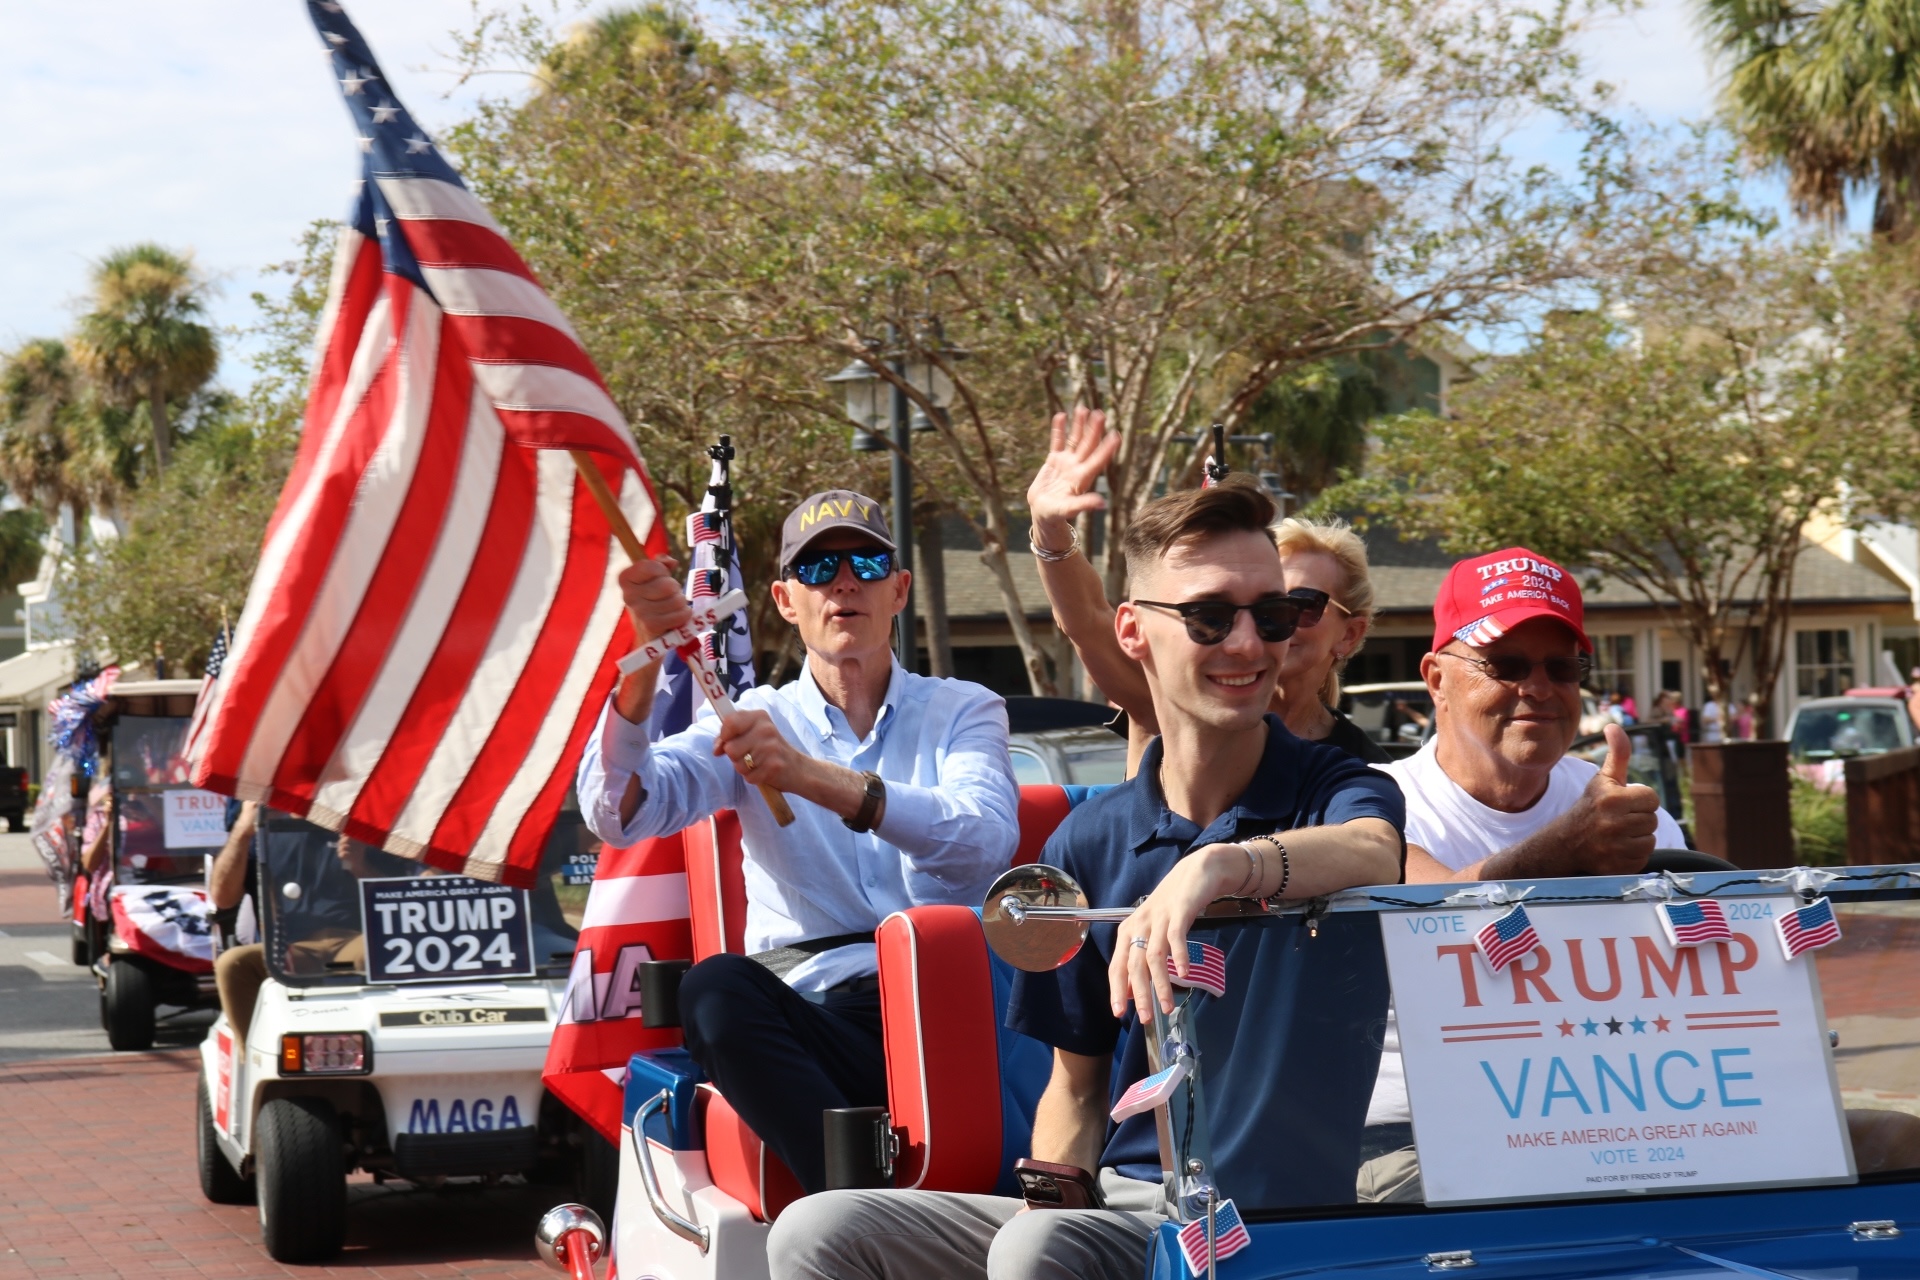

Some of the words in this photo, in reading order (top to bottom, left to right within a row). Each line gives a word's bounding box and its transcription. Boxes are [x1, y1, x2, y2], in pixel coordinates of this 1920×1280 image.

[800, 499, 869, 532] NAVY
[1477, 557, 1563, 582] TRUMP
[1521, 575, 1553, 591] 2024
[1479, 593, 1504, 608] TAKE
[1507, 589, 1549, 600] AMERICA
[1550, 595, 1570, 611] BACK
[375, 891, 403, 899] MAKE
[404, 889, 448, 898] AMERICA
[448, 887, 480, 896] GREAT
[481, 885, 513, 894] AGAIN
[374, 897, 516, 935] TRUMP
[1728, 902, 1774, 921] 2024
[1406, 915, 1467, 935] VOTE
[383, 932, 516, 974] 2024
[1436, 932, 1759, 1007] TRUMP
[419, 1011, 466, 1025] Club
[469, 1008, 508, 1023] Car
[1479, 1047, 1762, 1119] VANCE
[408, 1095, 524, 1134] MAGA
[1507, 1131, 1557, 1149] MAKE
[1561, 1126, 1639, 1146] AMERICA
[1641, 1123, 1698, 1141] GREAT
[1702, 1120, 1759, 1138] AGAIN!
[1590, 1148, 1638, 1165] VOTE
[1647, 1146, 1685, 1162] 2024
[1620, 1174, 1629, 1182] BY
[1631, 1172, 1662, 1181] FRIENDS
[1663, 1171, 1673, 1179] OF
[1673, 1170, 1698, 1178] TRUMP
